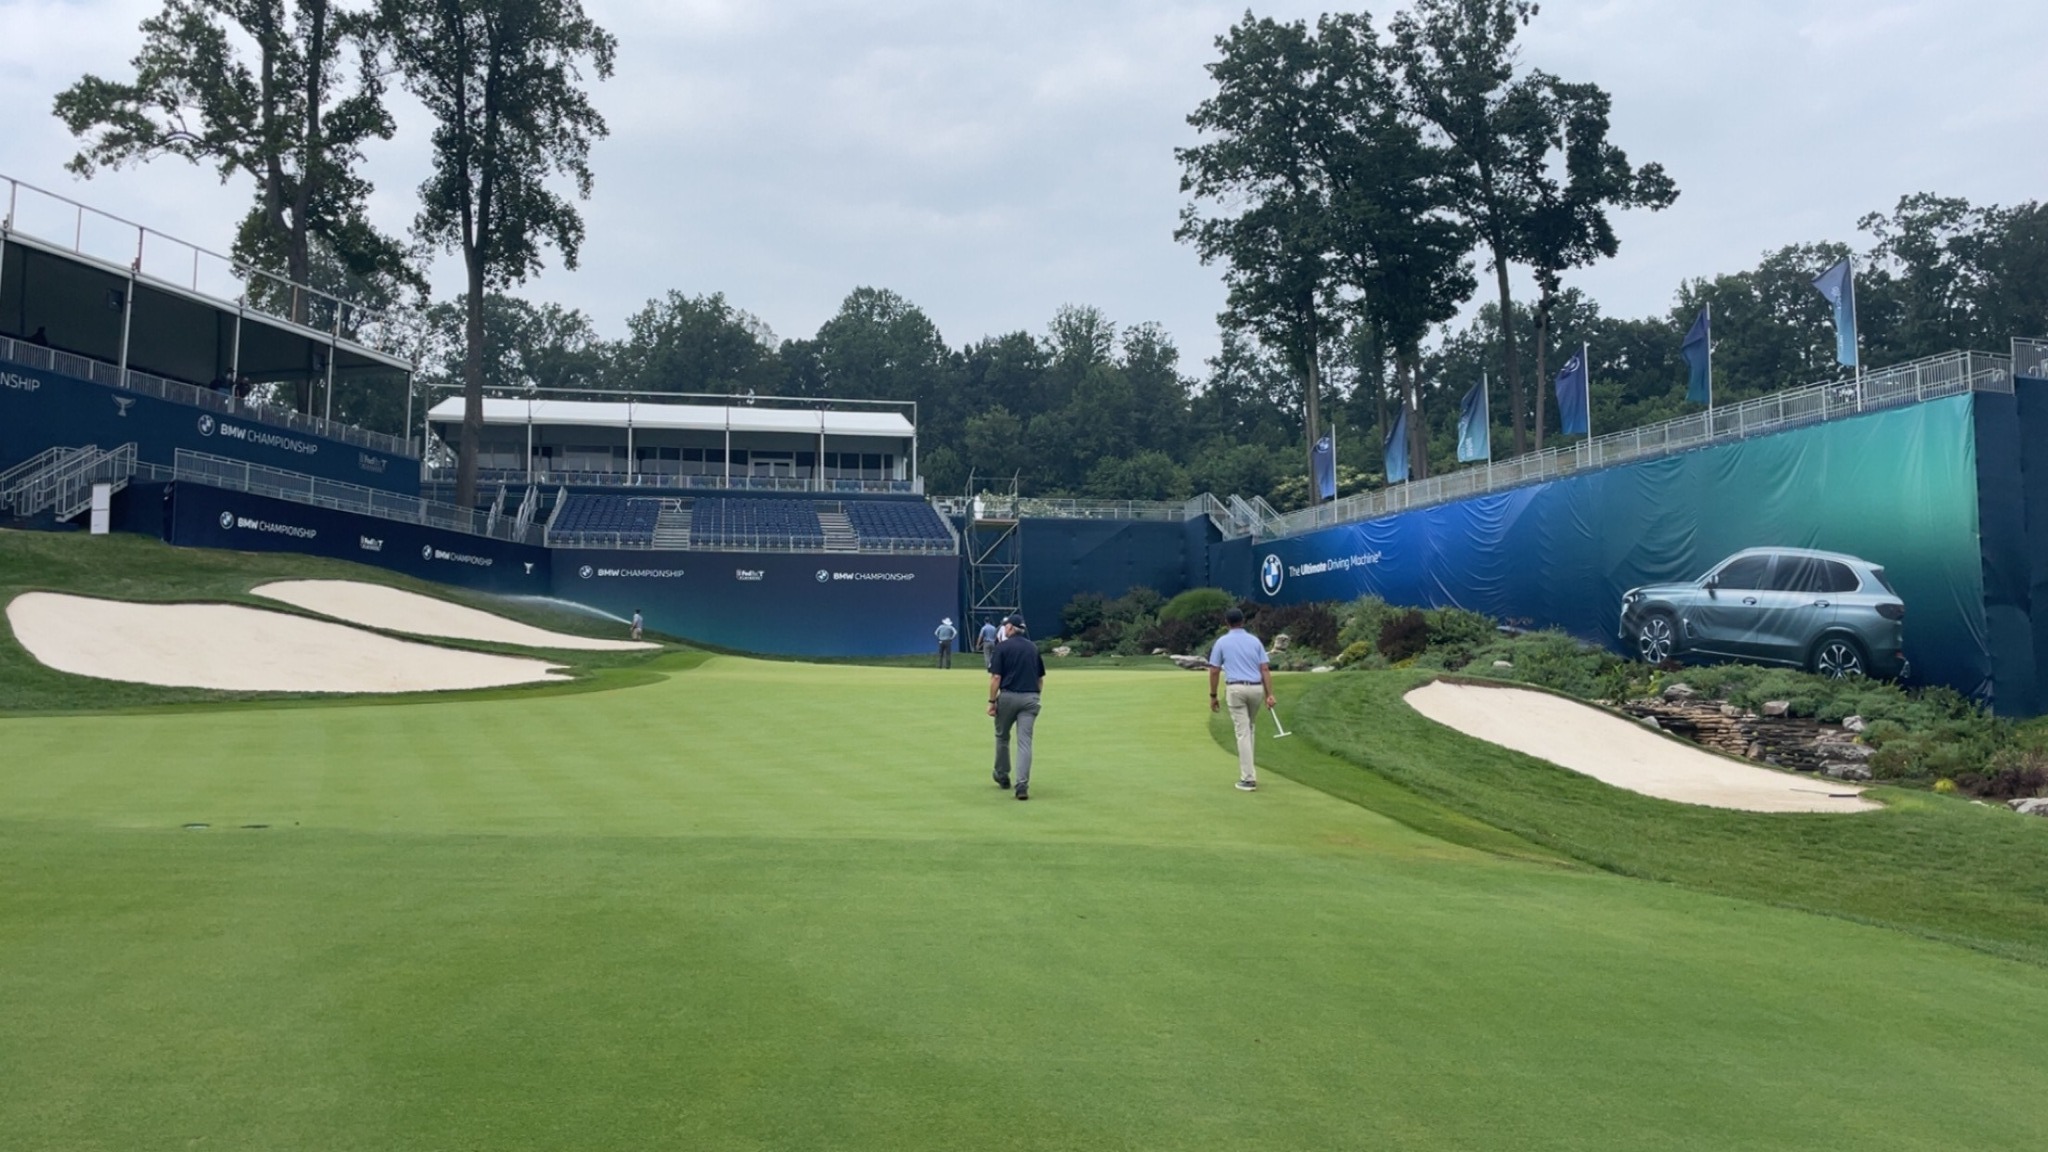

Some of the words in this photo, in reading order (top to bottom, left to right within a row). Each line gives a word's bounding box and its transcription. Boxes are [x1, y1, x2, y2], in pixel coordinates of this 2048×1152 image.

[220, 423, 247, 440] BMW
[247, 429, 318, 455] CHAMPIONSHIP
[237, 517, 259, 530] BMW
[259, 520, 317, 539] CHAMPIONSHIP
[434, 549, 450, 560] BMW
[597, 568, 620, 577] BMW
[620, 568, 684, 577] CHAMPIONSHIP
[1288, 566, 1301, 577] The
[1301, 561, 1327, 576] Ultimate
[1327, 557, 1350, 571] Driving
[833, 572, 854, 580] BMW
[854, 572, 915, 581] CHAMPIONSHIP
